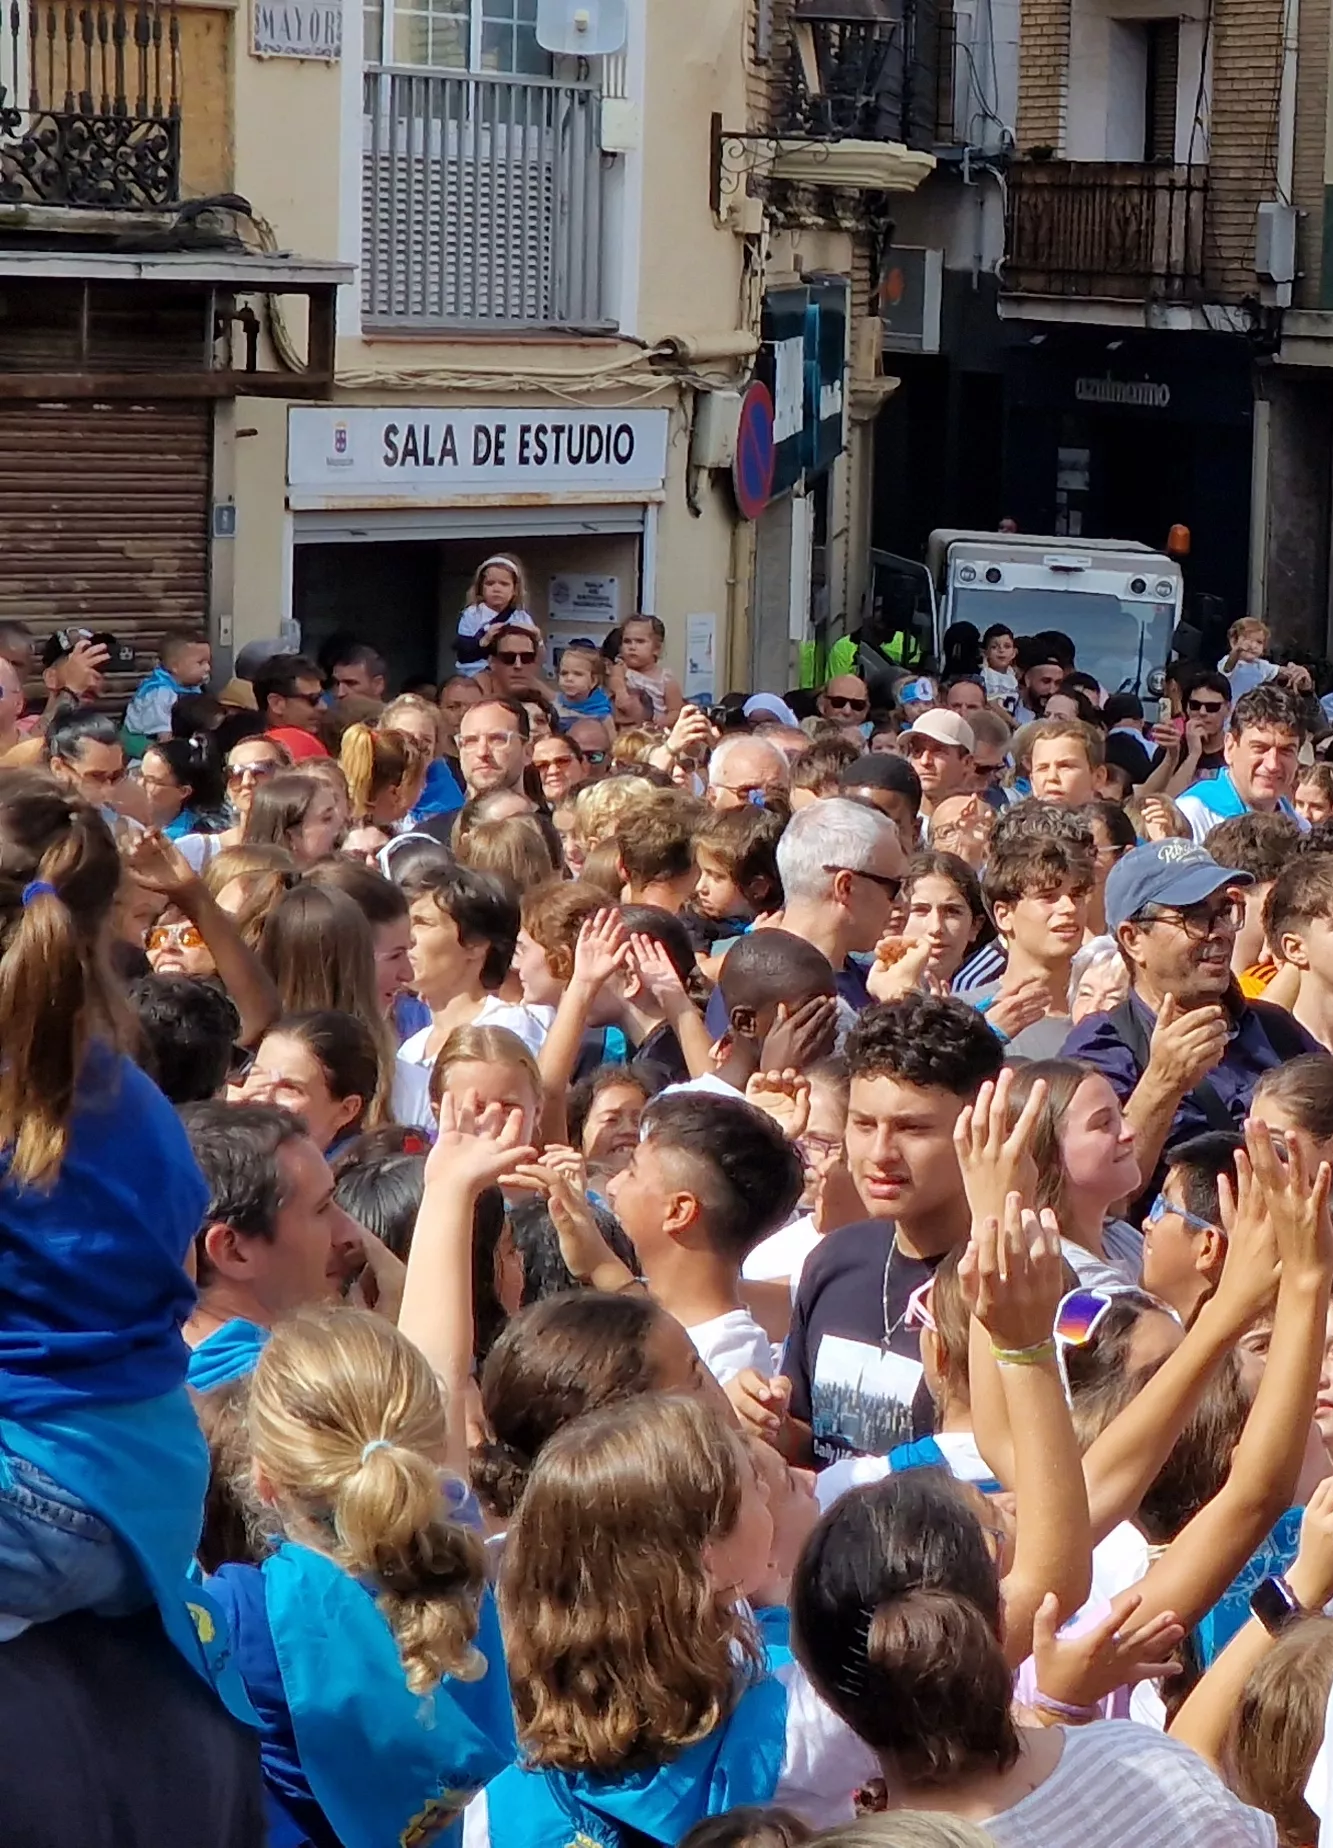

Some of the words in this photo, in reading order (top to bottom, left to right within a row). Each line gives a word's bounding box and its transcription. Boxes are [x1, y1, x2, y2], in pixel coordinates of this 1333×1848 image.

[262, 6, 335, 45] MAYOR
[383, 423, 459, 467] SALA
[472, 424, 506, 467] DE
[518, 422, 635, 467] ESTUDIO
